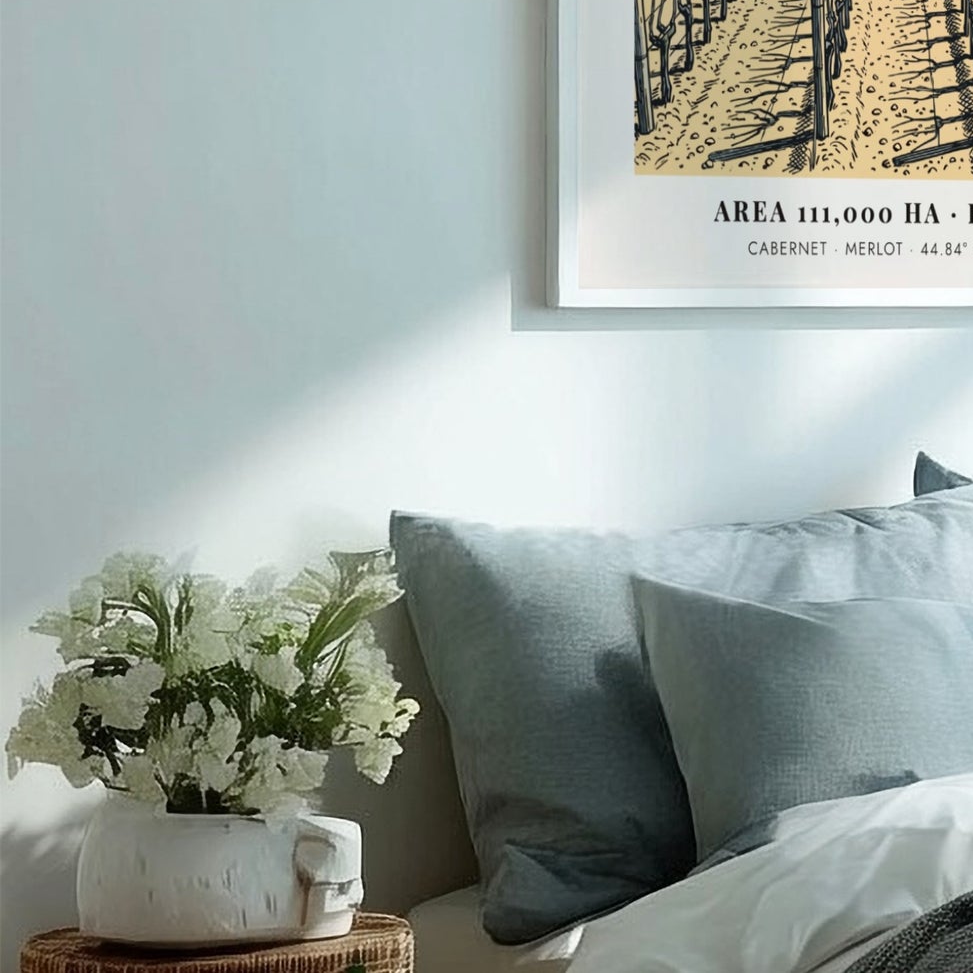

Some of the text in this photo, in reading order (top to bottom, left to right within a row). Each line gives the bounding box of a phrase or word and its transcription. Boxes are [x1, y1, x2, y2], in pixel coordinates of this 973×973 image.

[713, 199, 787, 224] AREA
[797, 206, 893, 228] 111,000
[903, 202, 941, 225] HA
[747, 240, 828, 256] CABERNET
[844, 241, 903, 257] MERLOT
